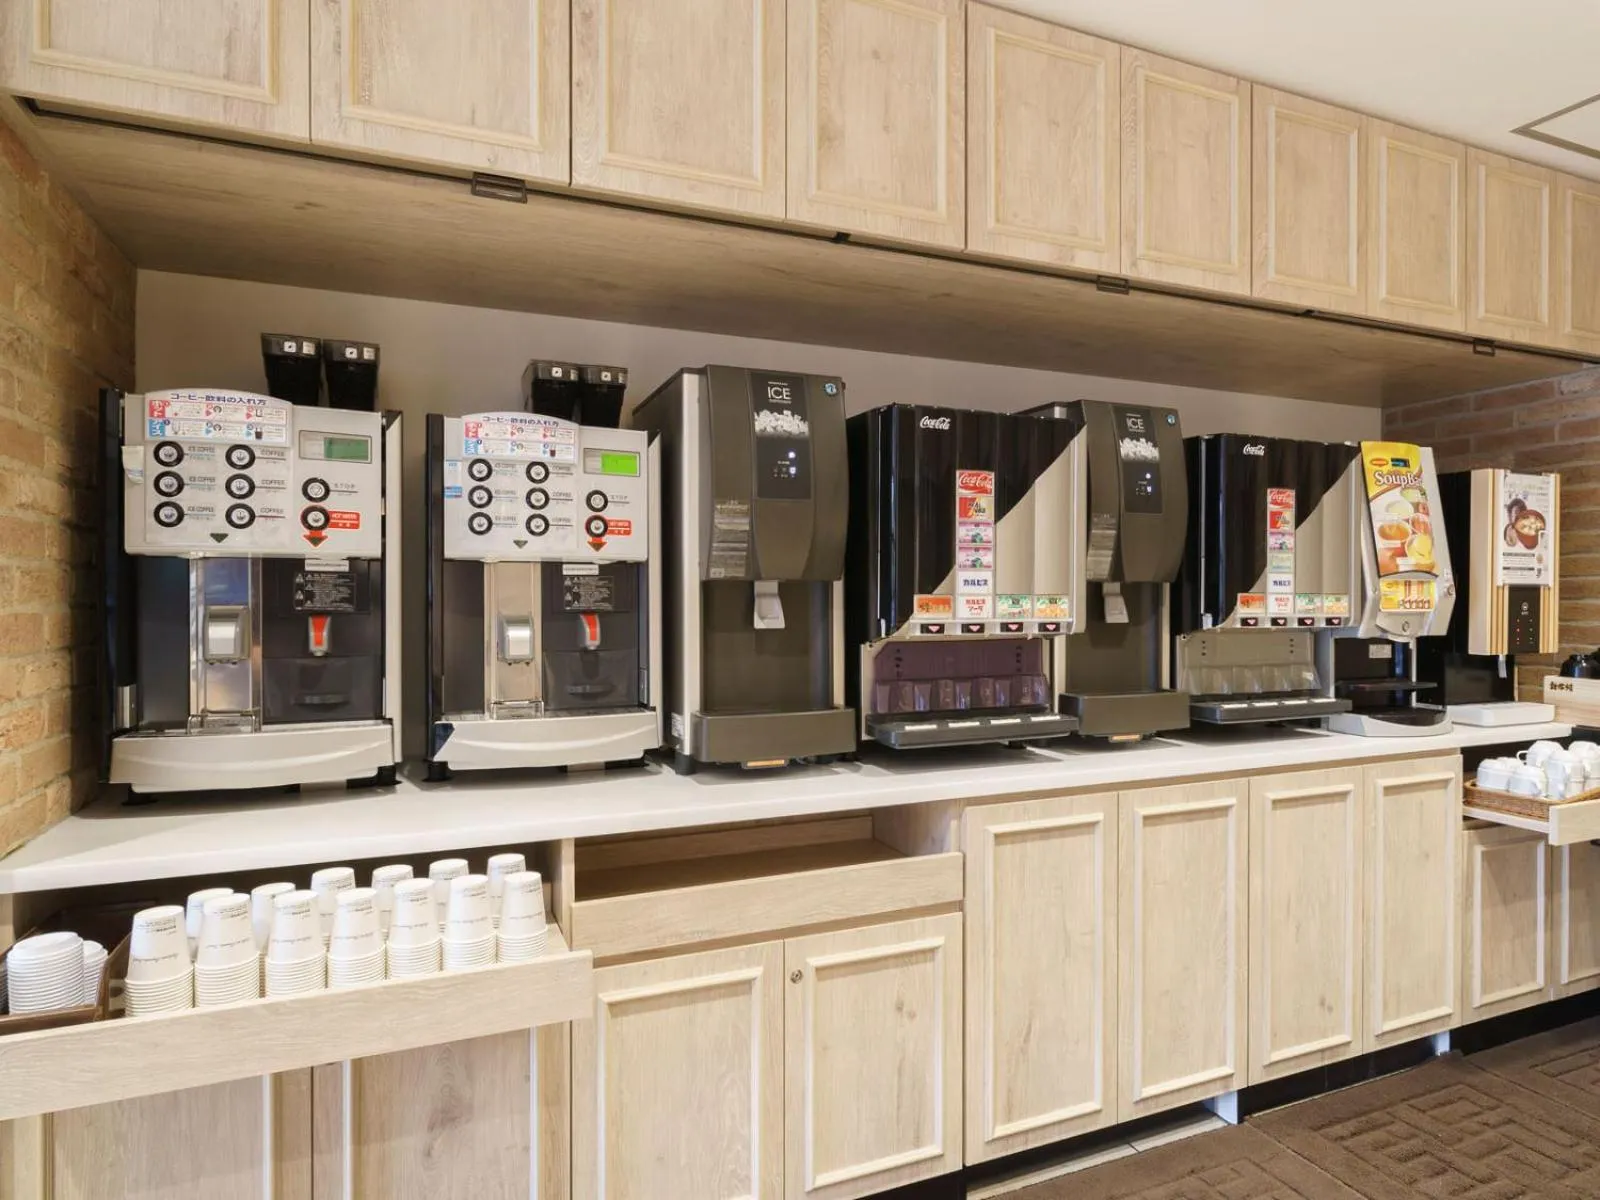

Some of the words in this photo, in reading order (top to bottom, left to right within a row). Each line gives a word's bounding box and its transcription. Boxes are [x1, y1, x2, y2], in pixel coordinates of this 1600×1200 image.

[170, 392, 267, 406] コーヒー飲料の入れ方
[767, 386, 792, 400] ICE
[482, 416, 559, 427] コーヒー飲料の入れ方
[1126, 417, 1145, 429] ICE
